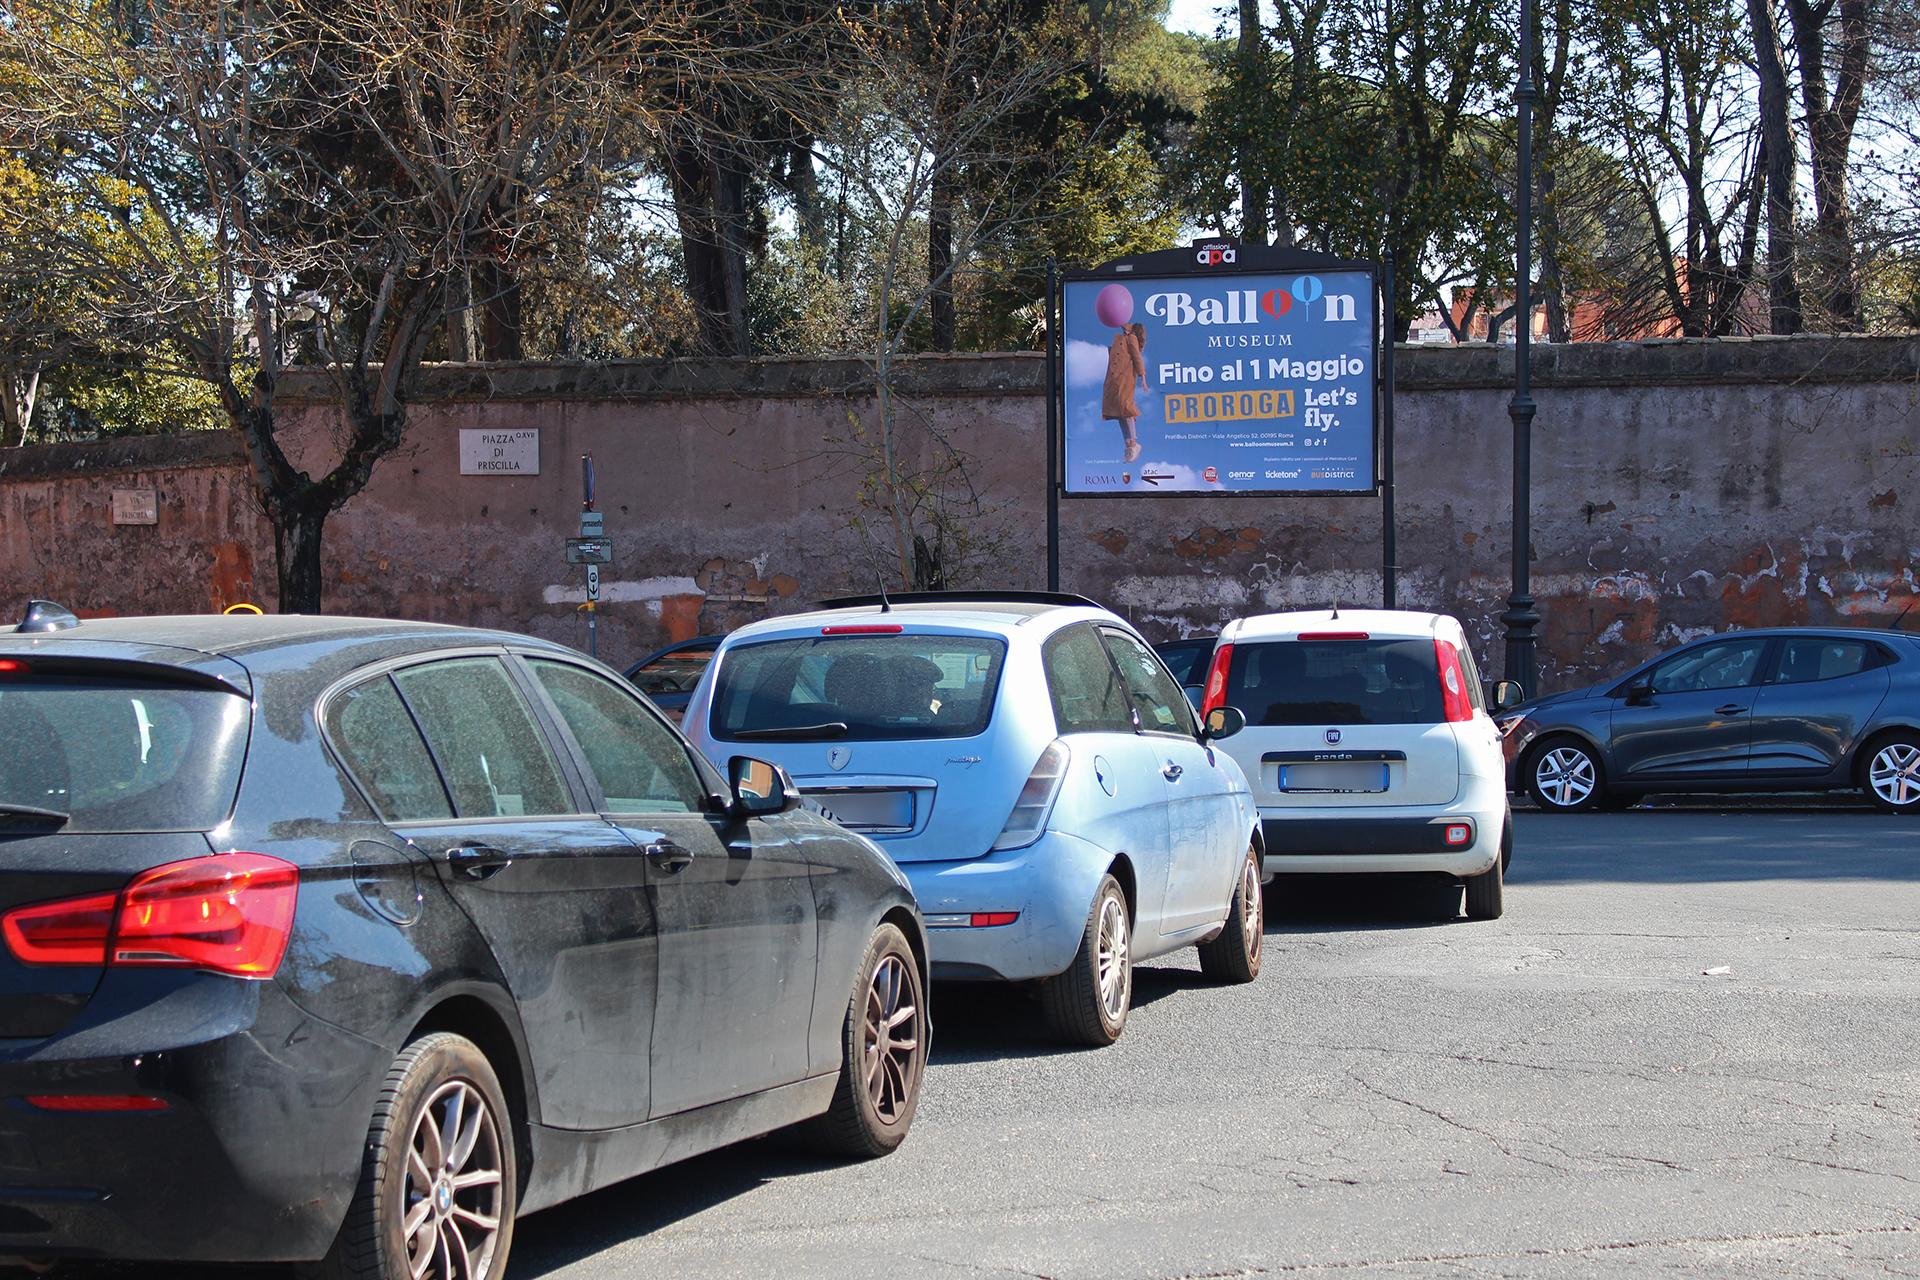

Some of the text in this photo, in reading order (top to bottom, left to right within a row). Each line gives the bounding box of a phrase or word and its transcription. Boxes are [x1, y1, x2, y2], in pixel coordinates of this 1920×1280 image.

[1196, 249, 1236, 266] apa
[1144, 275, 1357, 326] Balloon
[1208, 335, 1292, 348] MUSEUM
[1159, 354, 1364, 384] Fino al 1 Maggio
[1304, 386, 1358, 406] Let's
[1168, 392, 1291, 420] PROROGA
[1304, 408, 1340, 432] fly.
[482, 434, 515, 444] PIAZZA
[494, 448, 504, 457] DI
[478, 461, 520, 470] PRISCILLA
[1084, 475, 1117, 485] ROMA
[1328, 732, 1339, 740] FIAT
